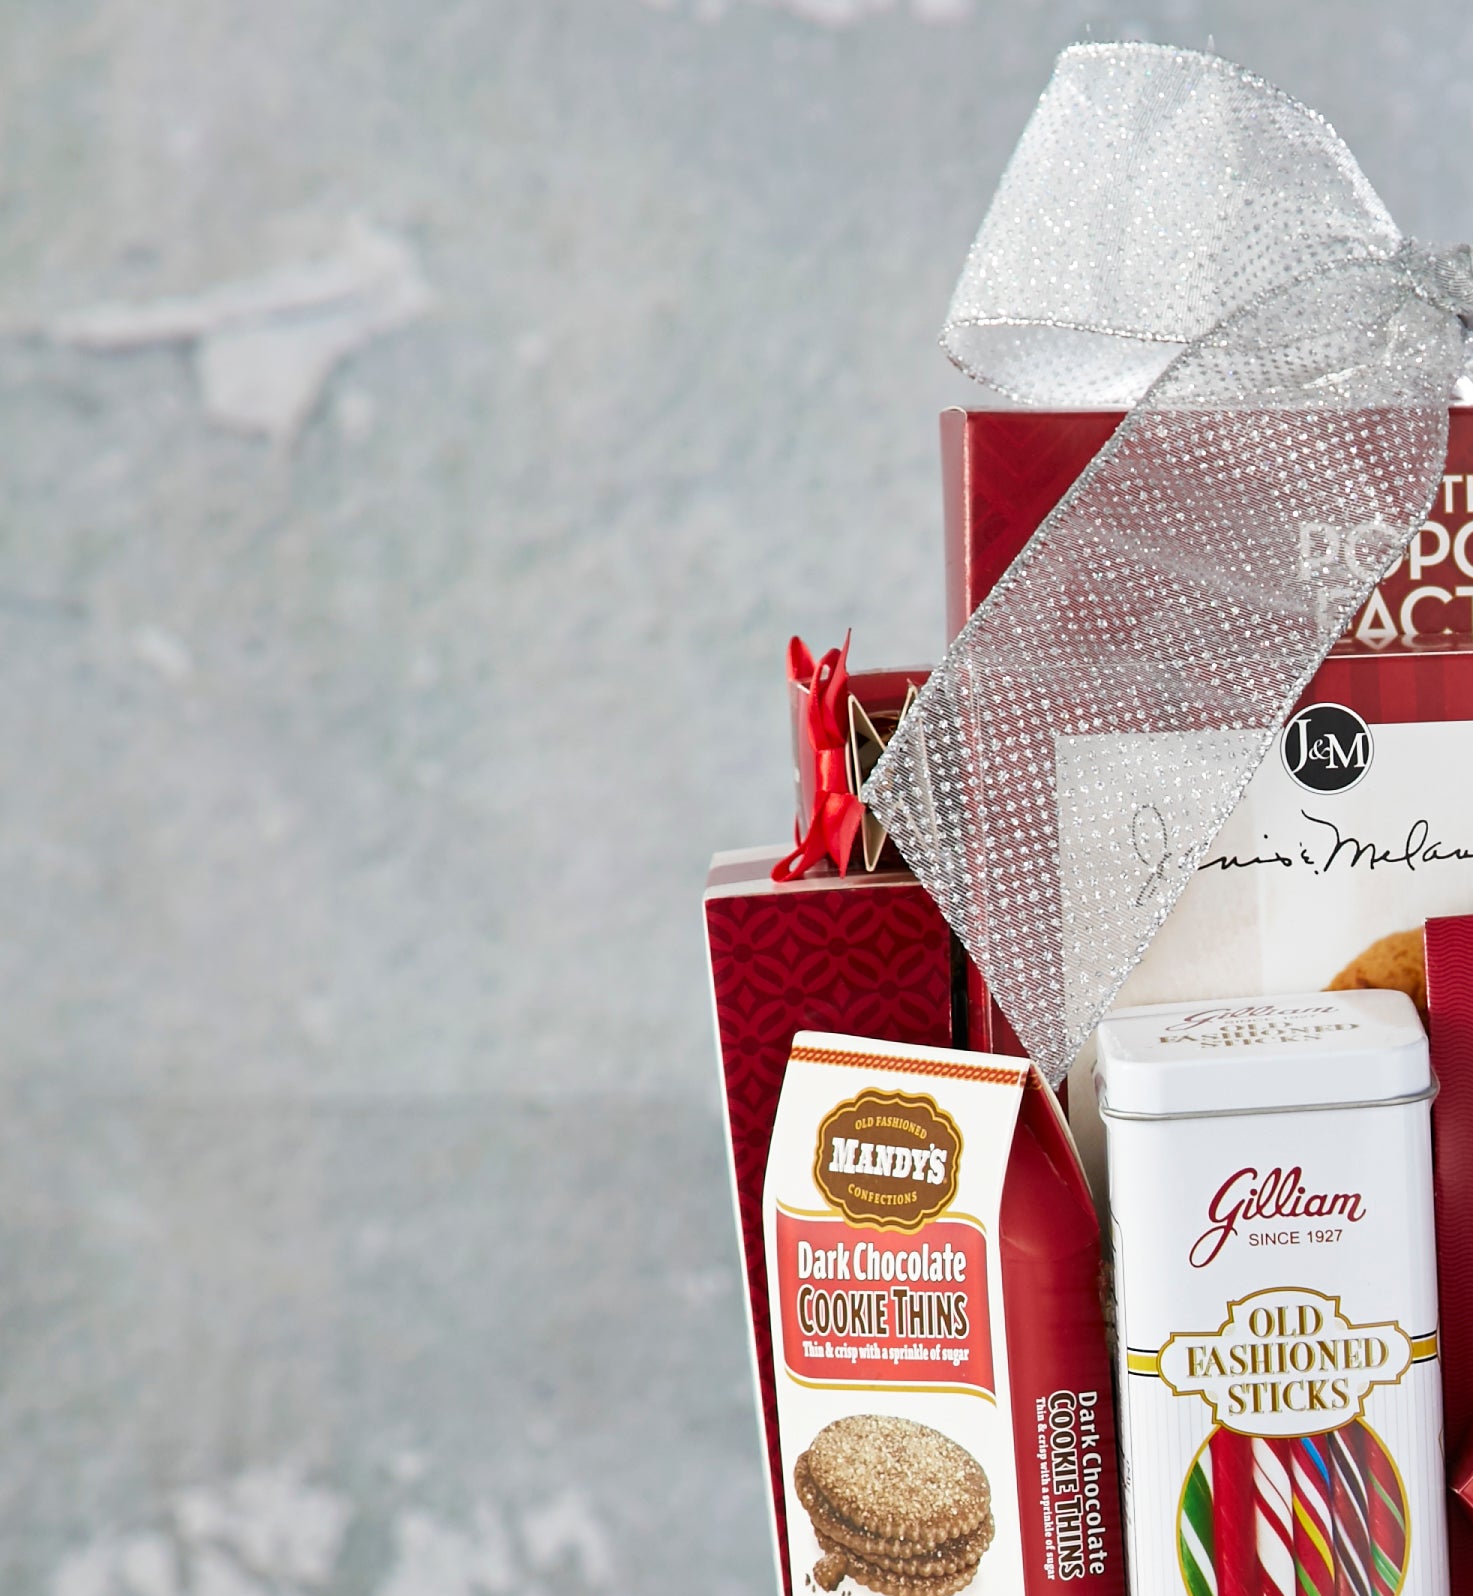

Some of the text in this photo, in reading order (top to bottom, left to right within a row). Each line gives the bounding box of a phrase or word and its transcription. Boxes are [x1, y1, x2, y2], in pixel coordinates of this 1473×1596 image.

[1292, 719, 1369, 773] J&M
[855, 1116, 928, 1139] OLD FASHIONED
[828, 1137, 948, 1185] MANDY'S
[848, 1183, 918, 1205] CONFECTIONS
[1189, 1166, 1366, 1268] Gilliam
[1248, 1229, 1343, 1246] SINCE 1927
[797, 1240, 967, 1283] Dark Chocolate
[798, 1285, 969, 1340] COOKIE THINS
[1249, 1304, 1324, 1338] OLD
[802, 1340, 969, 1367] Thin & crisp with a sprinkle of sugar
[1185, 1336, 1390, 1377] FASHIONED
[1036, 1396, 1047, 1421] Thin
[1228, 1378, 1351, 1417] STICKS
[1036, 1434, 1049, 1460] crisp
[1040, 1462, 1051, 1485] with
[1047, 1390, 1086, 1581] COOKIE THINS
[1078, 1391, 1107, 1574] Dark Chocolate
[1039, 1495, 1055, 1538] sprinkle
[1045, 1539, 1056, 1550] of
[1043, 1552, 1056, 1580] sugar
